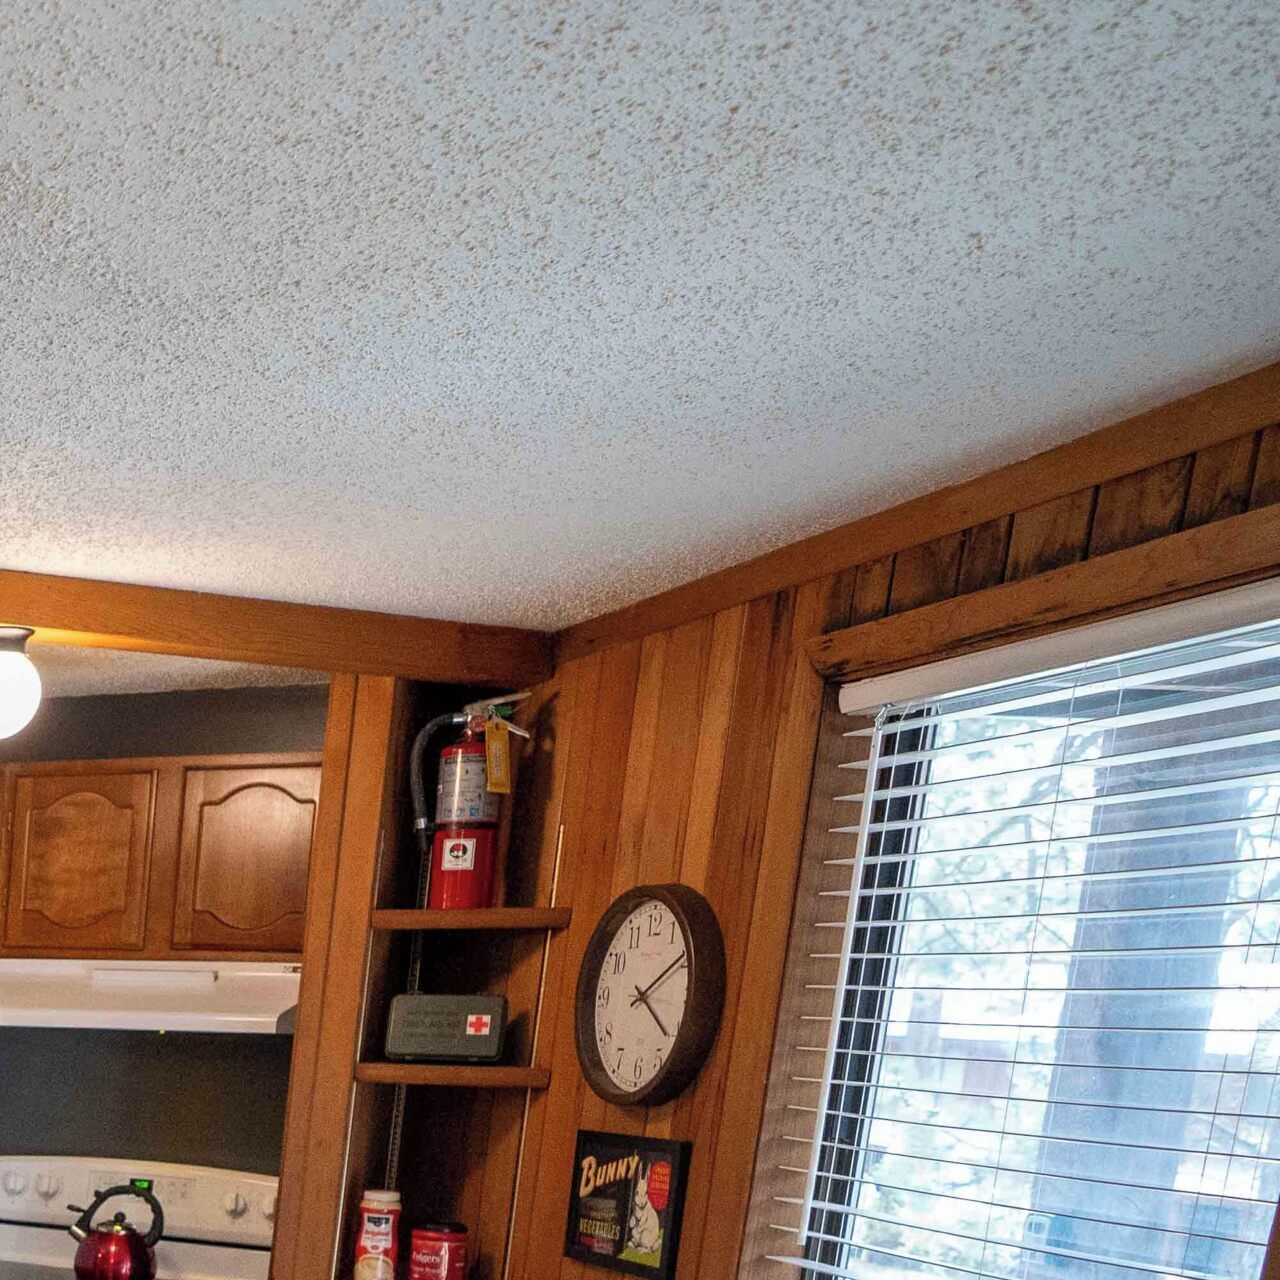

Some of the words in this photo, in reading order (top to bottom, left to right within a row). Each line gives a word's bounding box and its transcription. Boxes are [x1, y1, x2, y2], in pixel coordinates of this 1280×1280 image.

[645, 911, 662, 937] 12
[667, 920, 676, 945] 1
[628, 925, 641, 949] 11
[612, 951, 627, 975] 10
[601, 987, 610, 1009] 9
[604, 1023, 613, 1045] 8
[616, 1047, 625, 1071] 7
[633, 1056, 643, 1080] 6
[653, 1048, 663, 1071] 5
[579, 1154, 640, 1198] BUNNY
